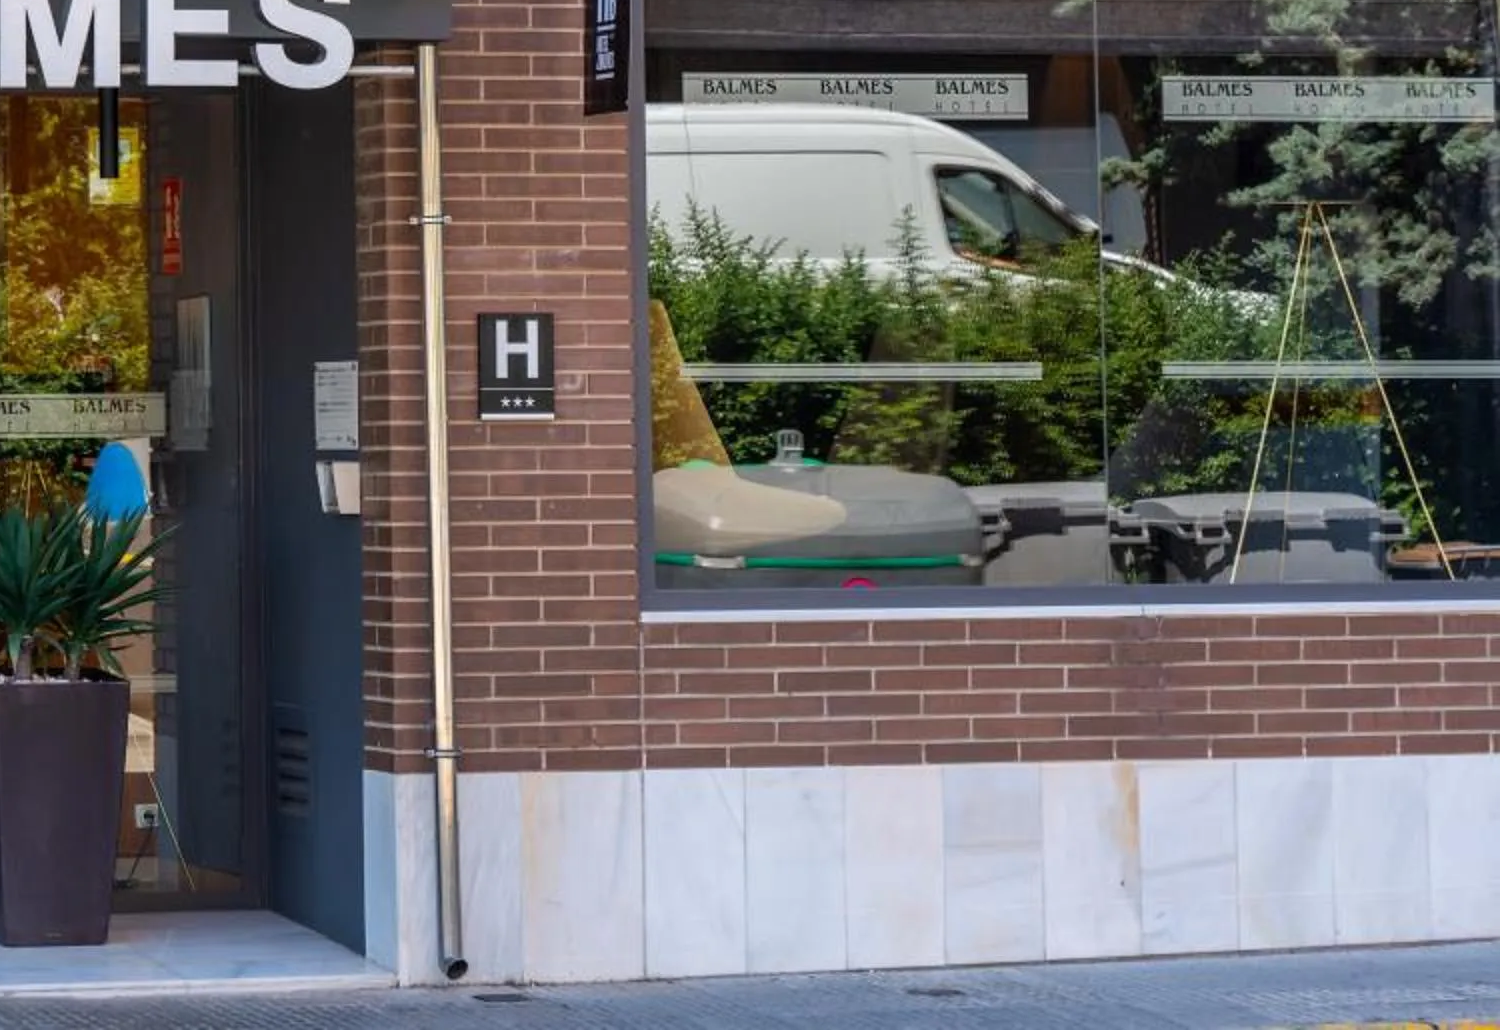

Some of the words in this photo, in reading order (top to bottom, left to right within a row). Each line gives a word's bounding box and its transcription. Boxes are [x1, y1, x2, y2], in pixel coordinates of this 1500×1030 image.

[703, 79, 777, 95] BALMES
[821, 79, 893, 95] BALMES
[936, 80, 1009, 95] BALMES
[1182, 82, 1253, 98] BALMES
[1295, 83, 1365, 98] BALMES
[1405, 82, 1477, 99] BALMES
[495, 320, 539, 379] H
[73, 398, 146, 414] BALMES
